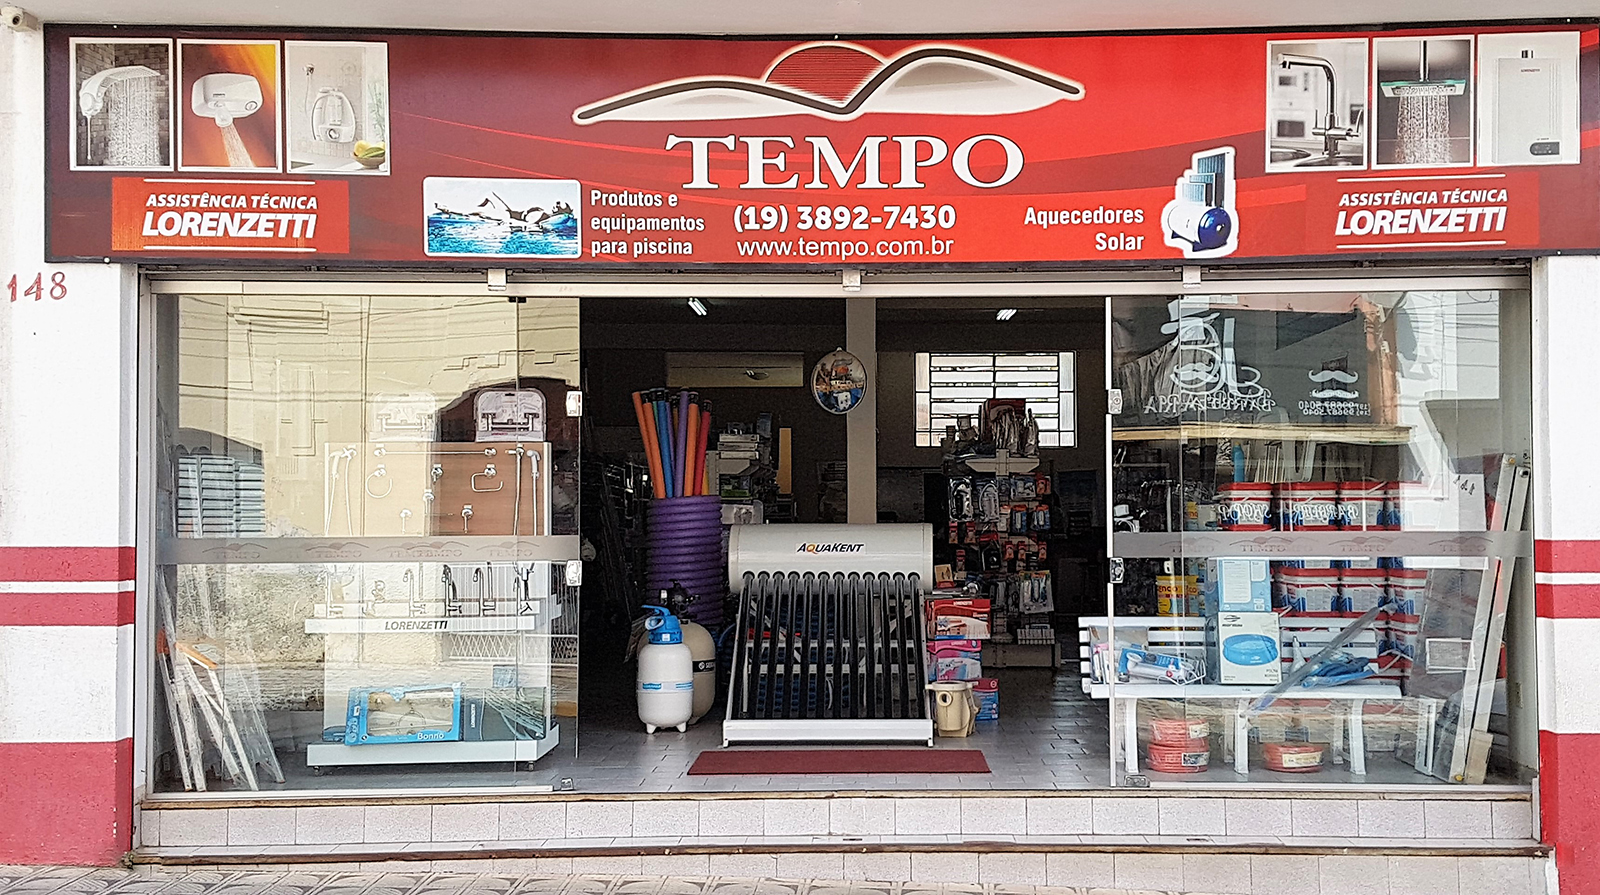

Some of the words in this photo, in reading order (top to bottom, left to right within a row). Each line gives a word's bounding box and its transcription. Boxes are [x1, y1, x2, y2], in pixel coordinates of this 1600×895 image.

[664, 134, 1025, 190] TEMPO
[145, 192, 247, 209] ASSISTÊNCIA
[250, 193, 318, 210] TÉCNICA
[590, 189, 663, 207] Produtos
[667, 193, 678, 207] e
[1338, 190, 1439, 207] ASSISTÊNCIA
[1442, 187, 1508, 204] TÉCNICA
[142, 210, 318, 239] LORENZETTI
[590, 213, 705, 234] equipamentos
[733, 204, 790, 232] (19)
[796, 205, 956, 230] 3892-7430
[1023, 205, 1145, 229] Aquecedores
[1335, 206, 1508, 236] LORENZETTI
[591, 240, 628, 258] para
[633, 237, 693, 258] piscina
[737, 235, 955, 260] www.tempo.com.br
[1094, 232, 1145, 251] Solar
[7, 271, 68, 302] 148
[796, 542, 865, 555] AQUAKENT
[384, 620, 448, 631] LORENZETTI
